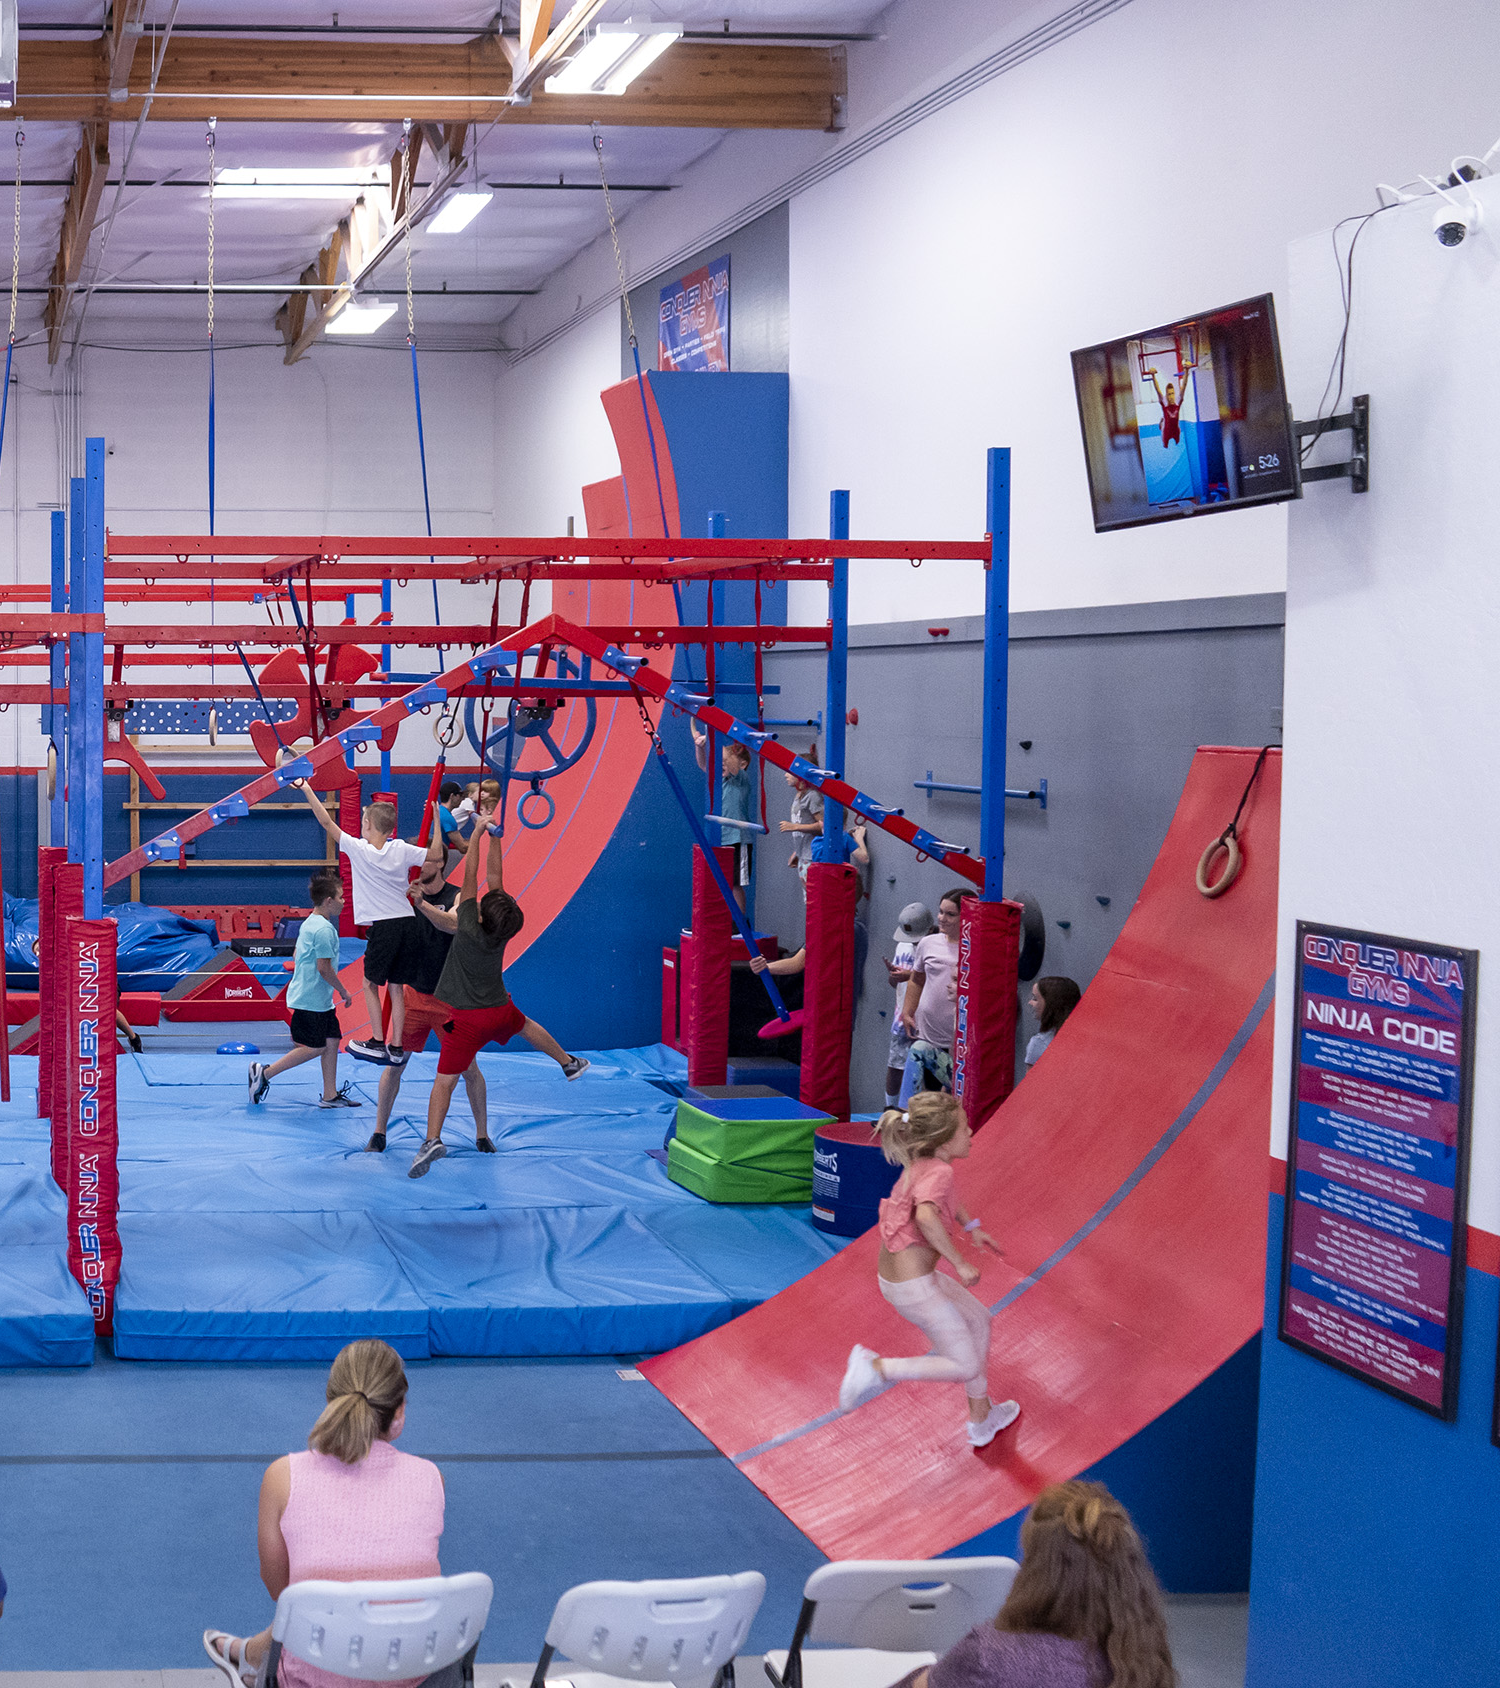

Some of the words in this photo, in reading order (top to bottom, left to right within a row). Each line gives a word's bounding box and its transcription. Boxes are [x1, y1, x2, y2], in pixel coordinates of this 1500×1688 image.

[1304, 934, 1399, 977] CONQUER
[1402, 951, 1464, 990] NINJA
[1347, 971, 1410, 1008] GYMS
[953, 994, 968, 1098] ONQUER
[1307, 999, 1375, 1036] NINJA
[1383, 1017, 1457, 1056] CODE
[79, 1018, 102, 1137] CONQUER
